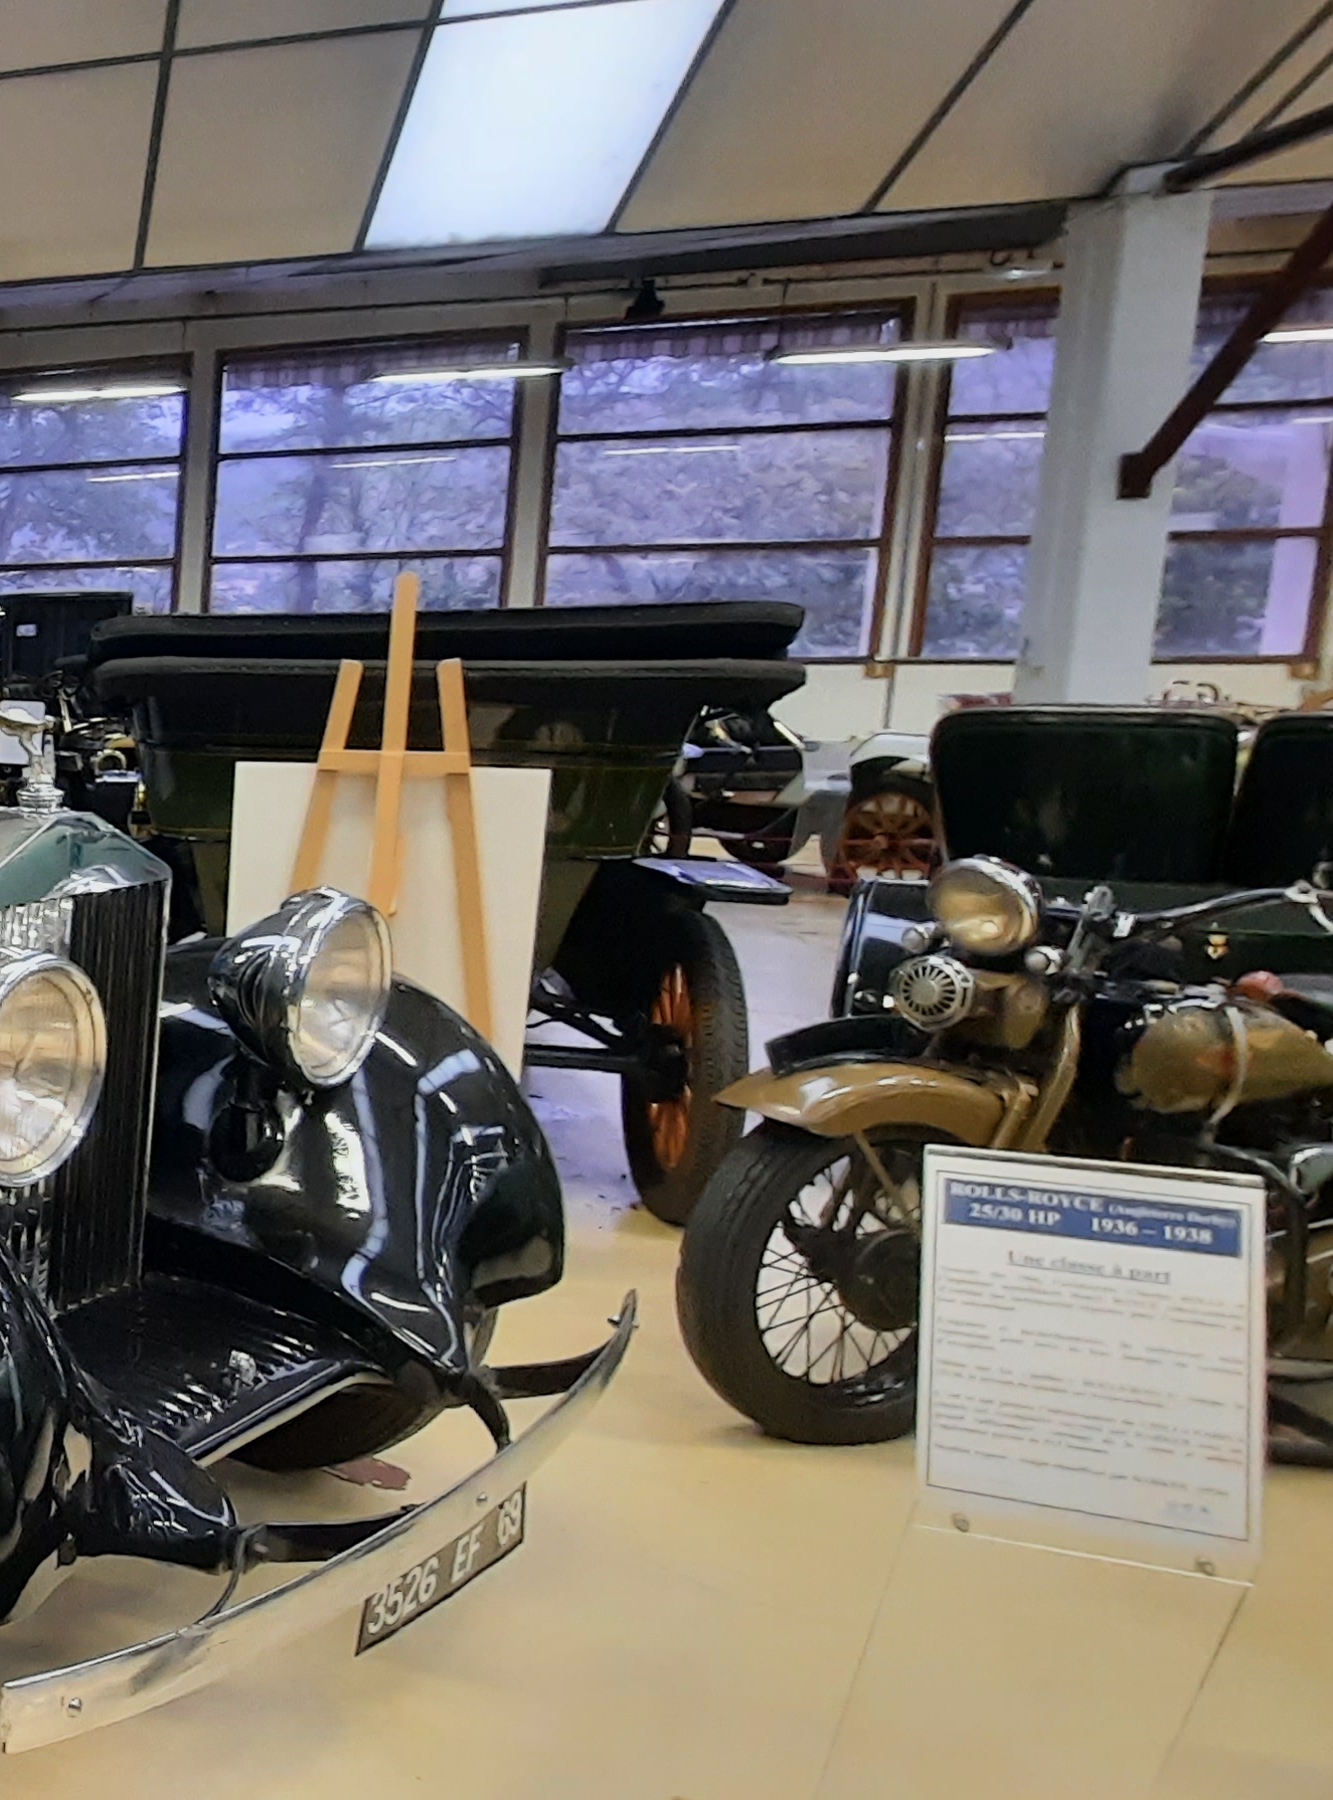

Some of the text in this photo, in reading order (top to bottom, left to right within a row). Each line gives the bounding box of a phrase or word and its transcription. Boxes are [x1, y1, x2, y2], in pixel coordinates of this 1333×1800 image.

[949, 1181, 1104, 1213] ROLLS-ROYCE
[969, 1202, 1023, 1223] 25/30
[1028, 1209, 1062, 1227] HP
[1091, 1216, 1139, 1237] 1936
[1162, 1224, 1213, 1245] 1938
[1007, 1250, 1045, 1268] Une
[1050, 1255, 1106, 1277] classe
[1129, 1266, 1171, 1285] part
[368, 1556, 439, 1634] 3526
[451, 1522, 484, 1584] EF
